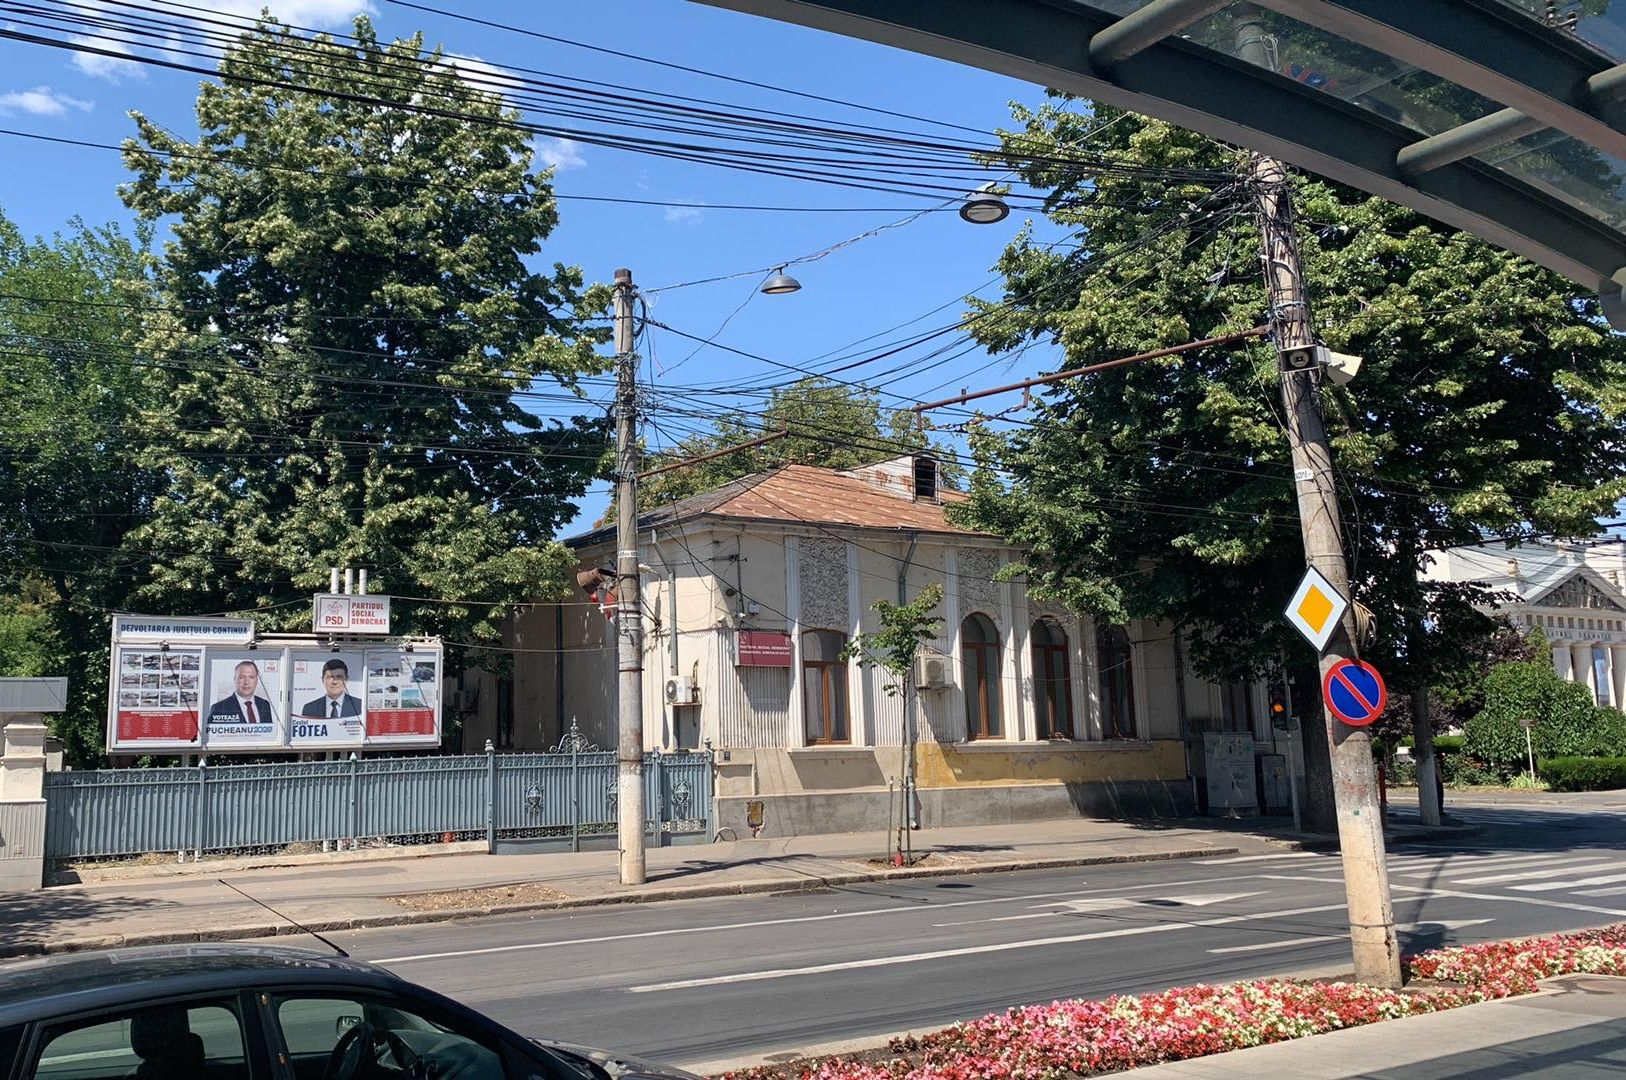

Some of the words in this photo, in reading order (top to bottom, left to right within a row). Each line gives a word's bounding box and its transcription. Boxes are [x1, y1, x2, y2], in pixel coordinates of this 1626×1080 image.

[351, 602, 384, 610] PARTIDUL
[351, 610, 375, 618] SOCIAL
[325, 616, 344, 625] PSD
[121, 624, 171, 633] DEZVOLTAREA
[205, 726, 254, 734] PUCHEANU
[292, 724, 328, 737] FOTEA
